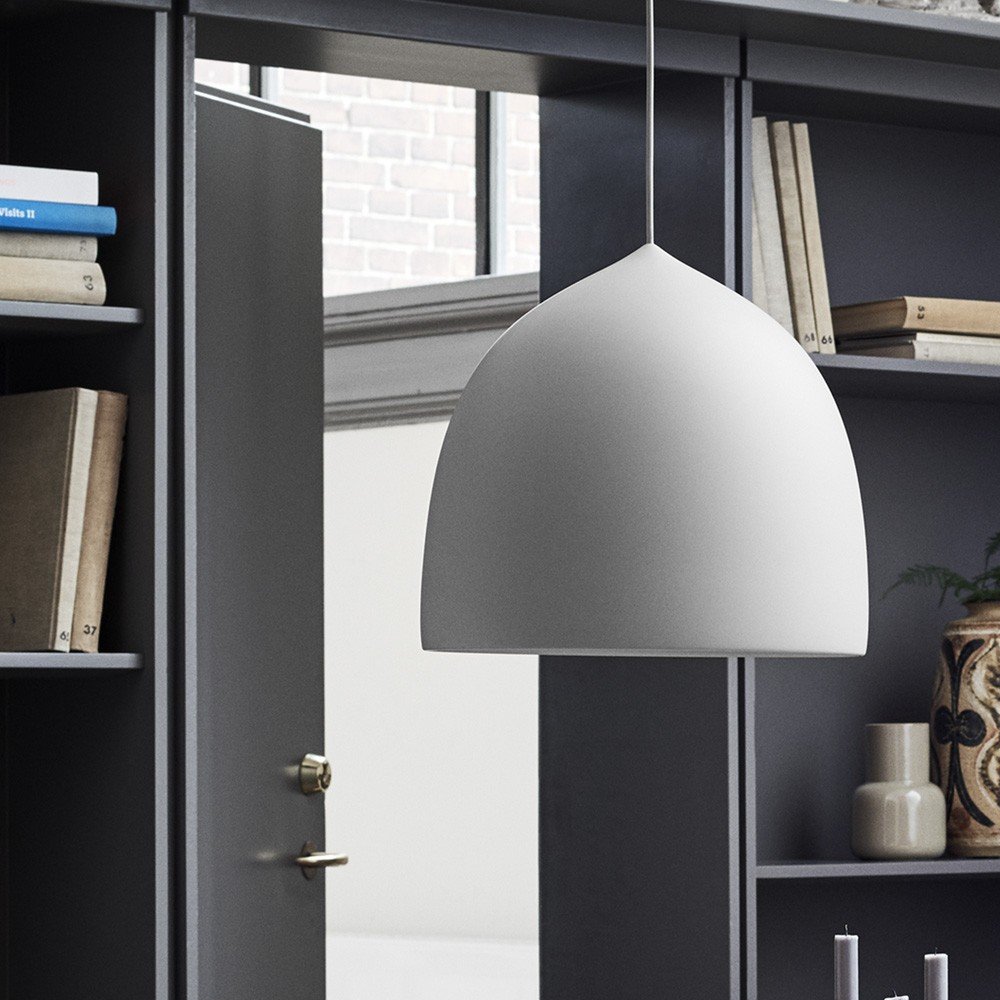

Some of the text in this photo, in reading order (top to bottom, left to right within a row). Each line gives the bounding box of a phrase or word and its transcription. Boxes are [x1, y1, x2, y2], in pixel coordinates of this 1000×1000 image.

[0, 207, 25, 218] Visits
[83, 275, 94, 291] 63
[83, 624, 97, 636] 37
